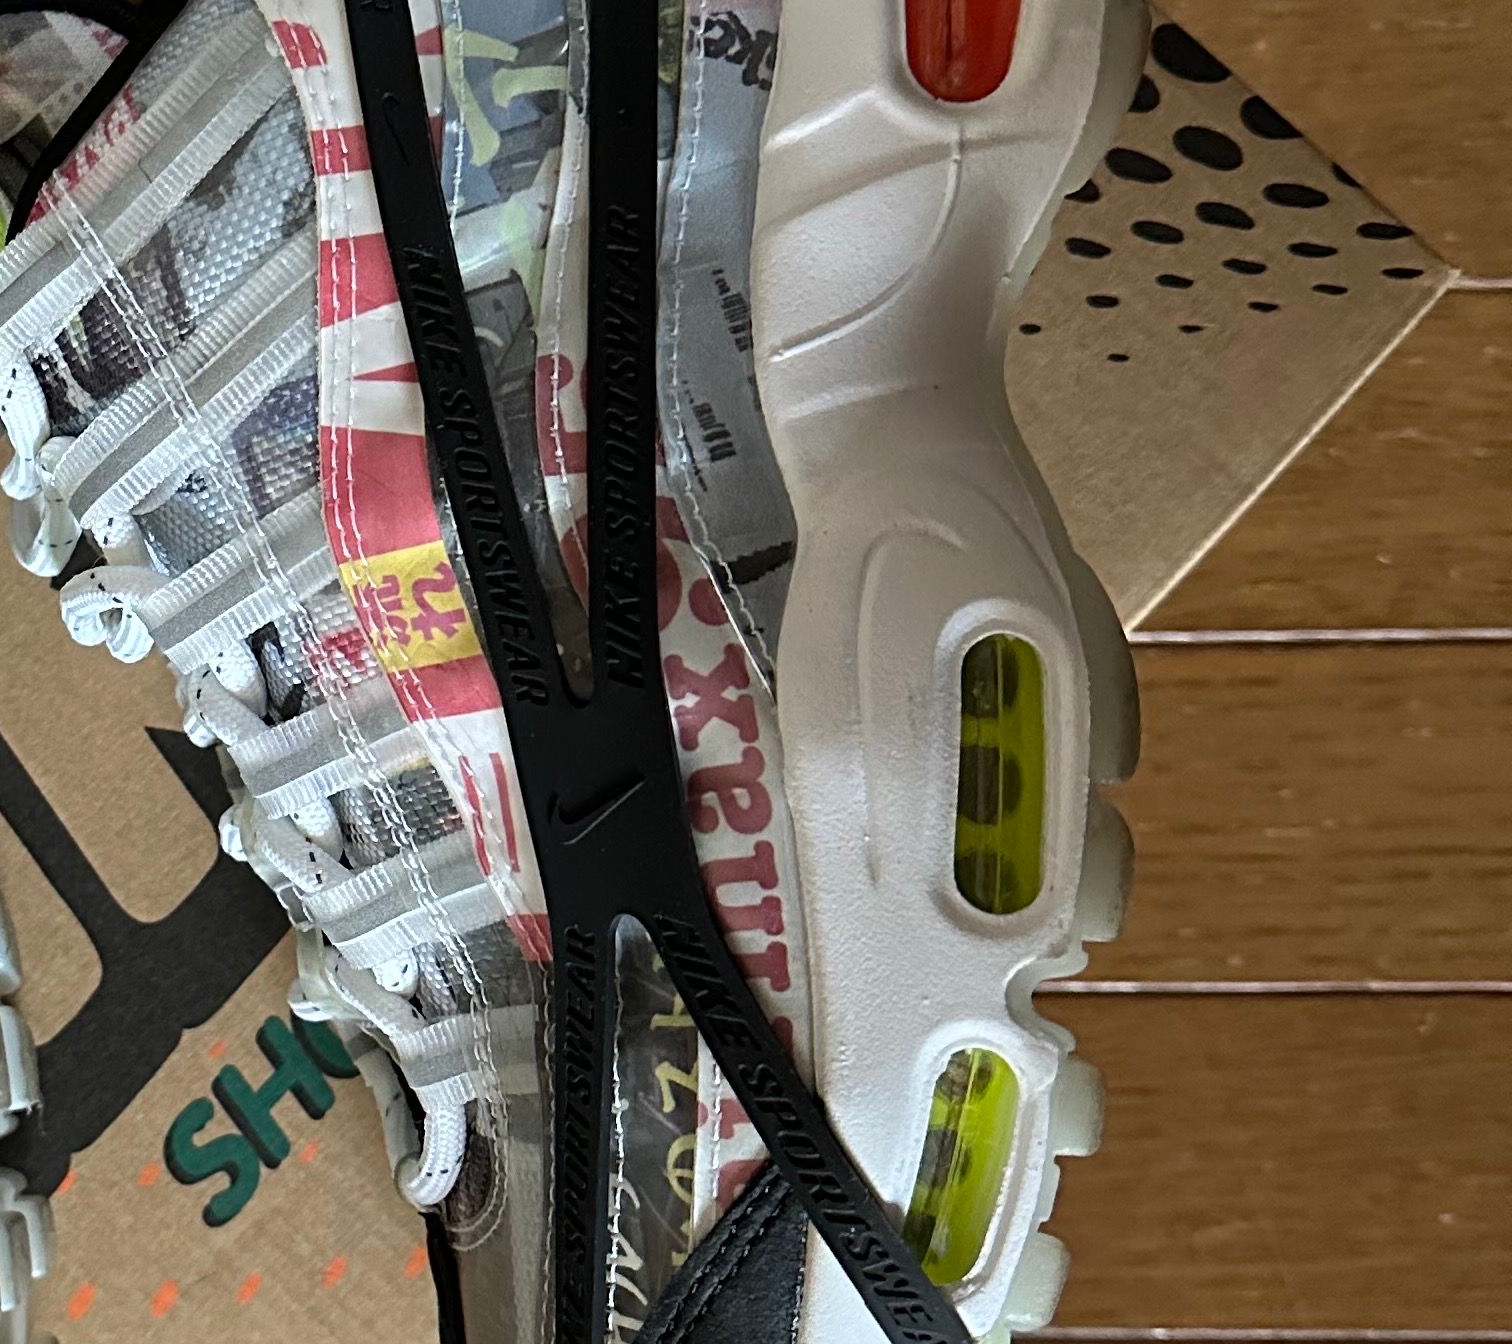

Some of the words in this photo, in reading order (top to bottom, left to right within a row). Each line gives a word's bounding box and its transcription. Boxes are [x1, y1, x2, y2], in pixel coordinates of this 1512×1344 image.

[400, 244, 468, 380] NIKE
[438, 386, 550, 708] SPORTSWEAR
[602, 200, 641, 546] SPORTSWEAR
[604, 556, 647, 690] NIKE
[562, 922, 596, 1258] SPORTSWEAR
[652, 911, 758, 1053] NIKE
